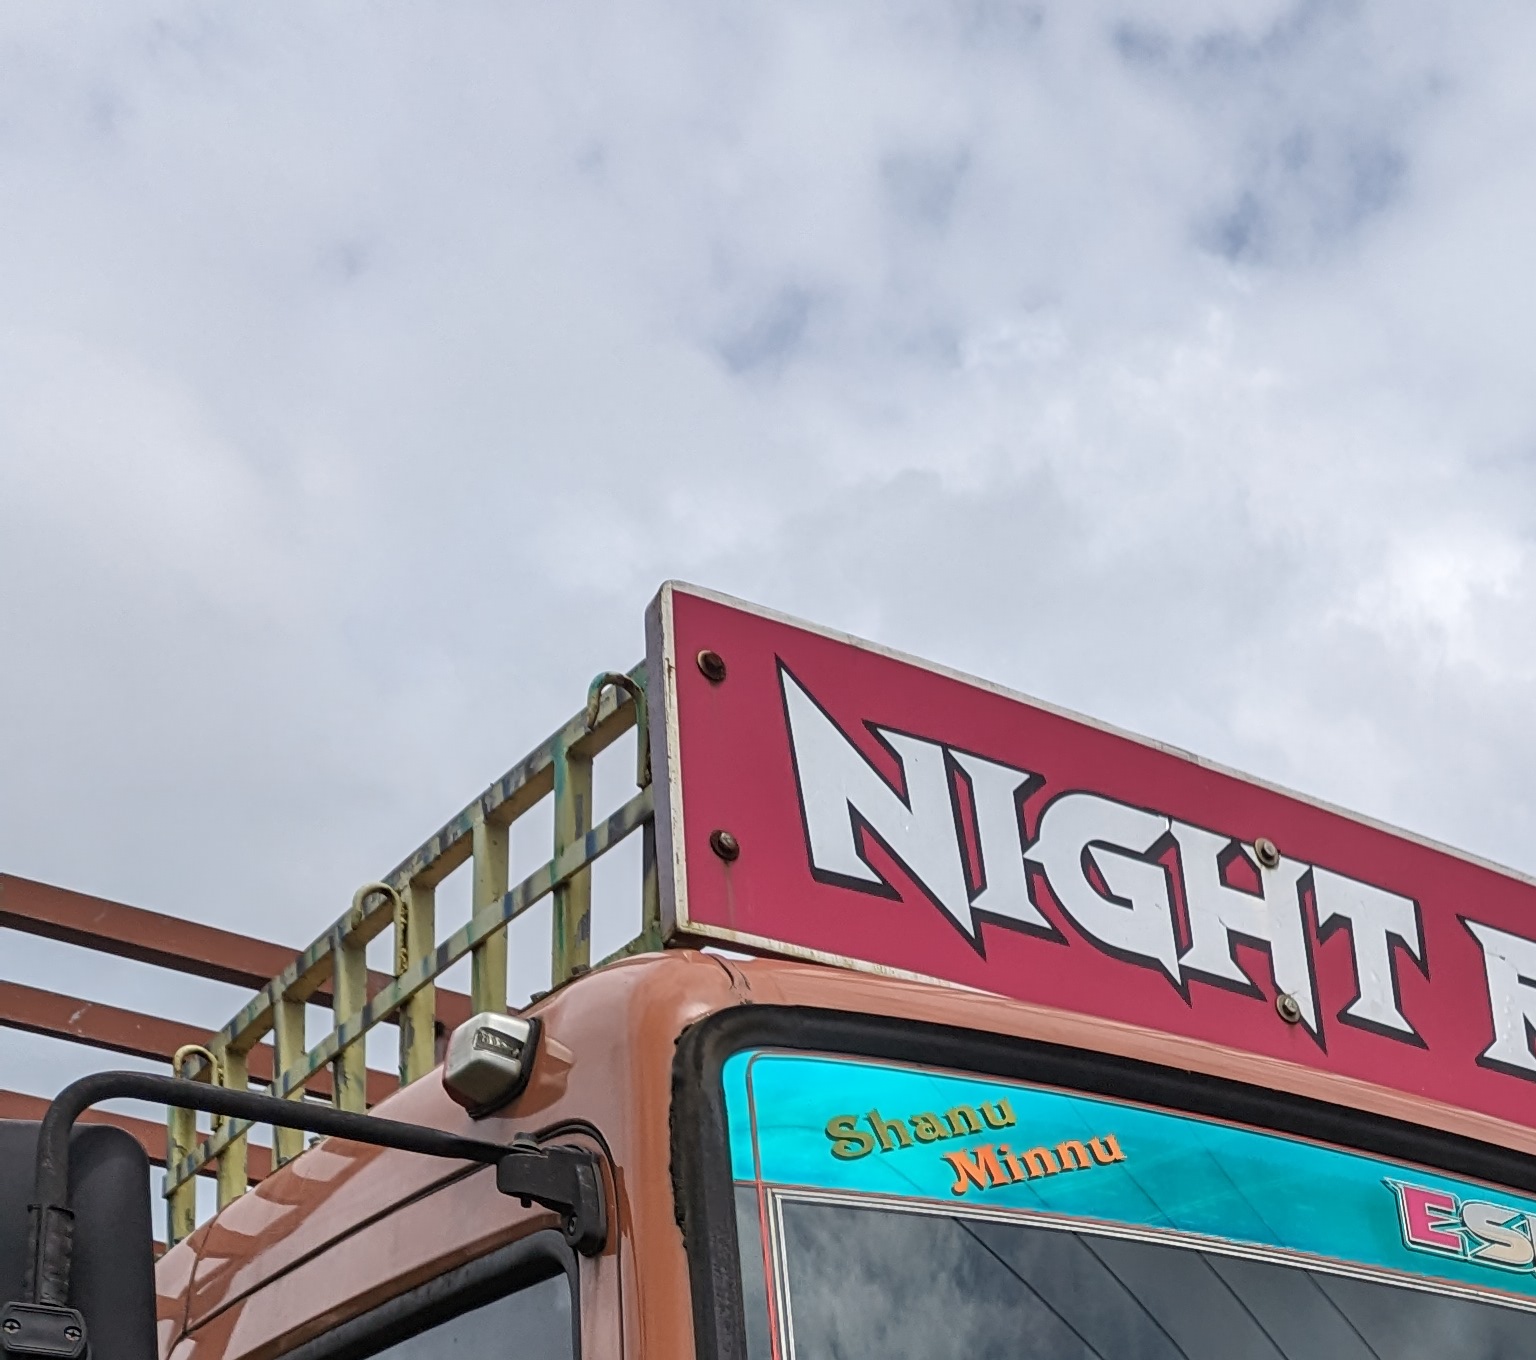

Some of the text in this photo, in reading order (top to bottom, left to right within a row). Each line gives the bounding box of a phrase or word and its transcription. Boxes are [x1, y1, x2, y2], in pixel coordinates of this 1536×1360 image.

[776, 654, 1430, 1053] NIGHT
[824, 1096, 1017, 1160] Shanu
[942, 1131, 1127, 1196] Minnu
